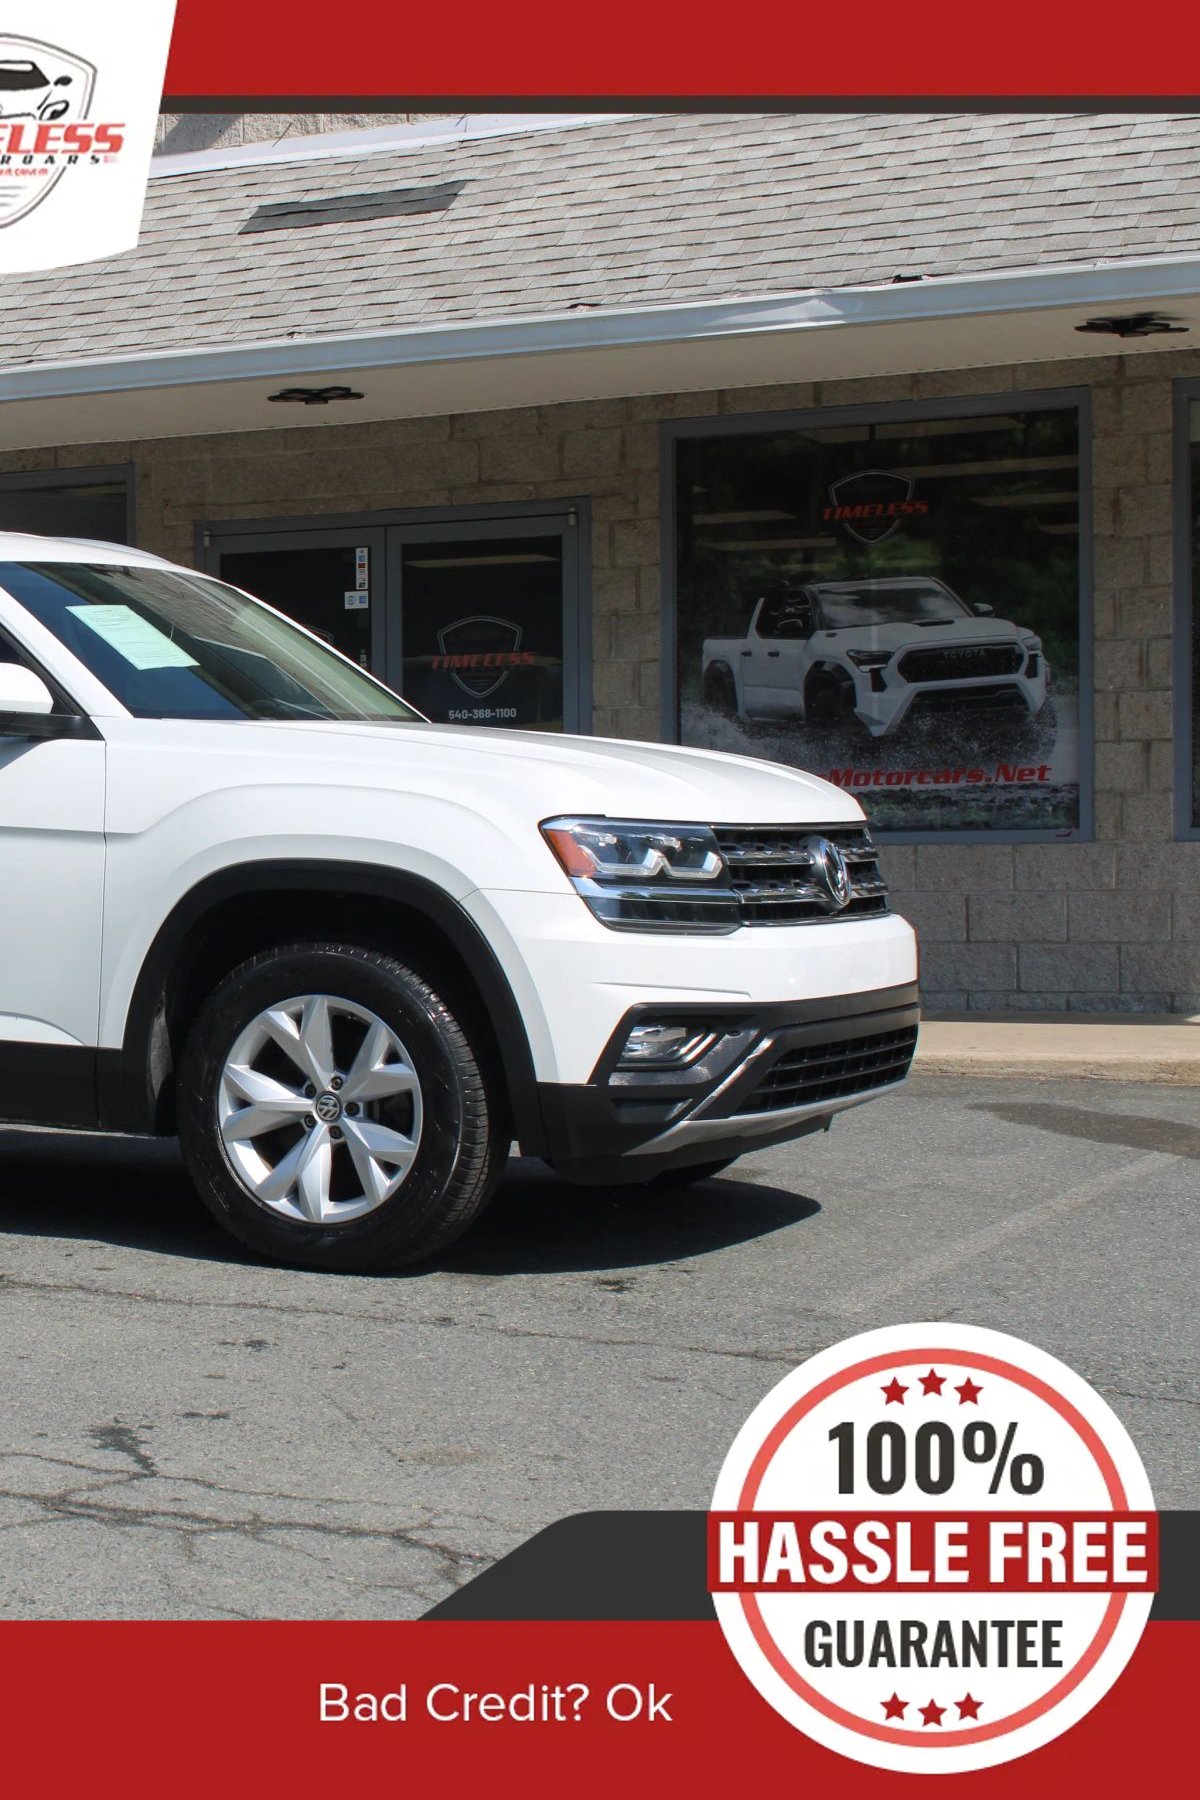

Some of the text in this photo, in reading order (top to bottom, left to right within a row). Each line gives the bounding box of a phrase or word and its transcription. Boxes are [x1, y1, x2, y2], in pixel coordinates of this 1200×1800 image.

[821, 500, 929, 522] TIMELESS
[432, 651, 536, 670] TIMELESS
[448, 707, 517, 721] 540-368-1100
